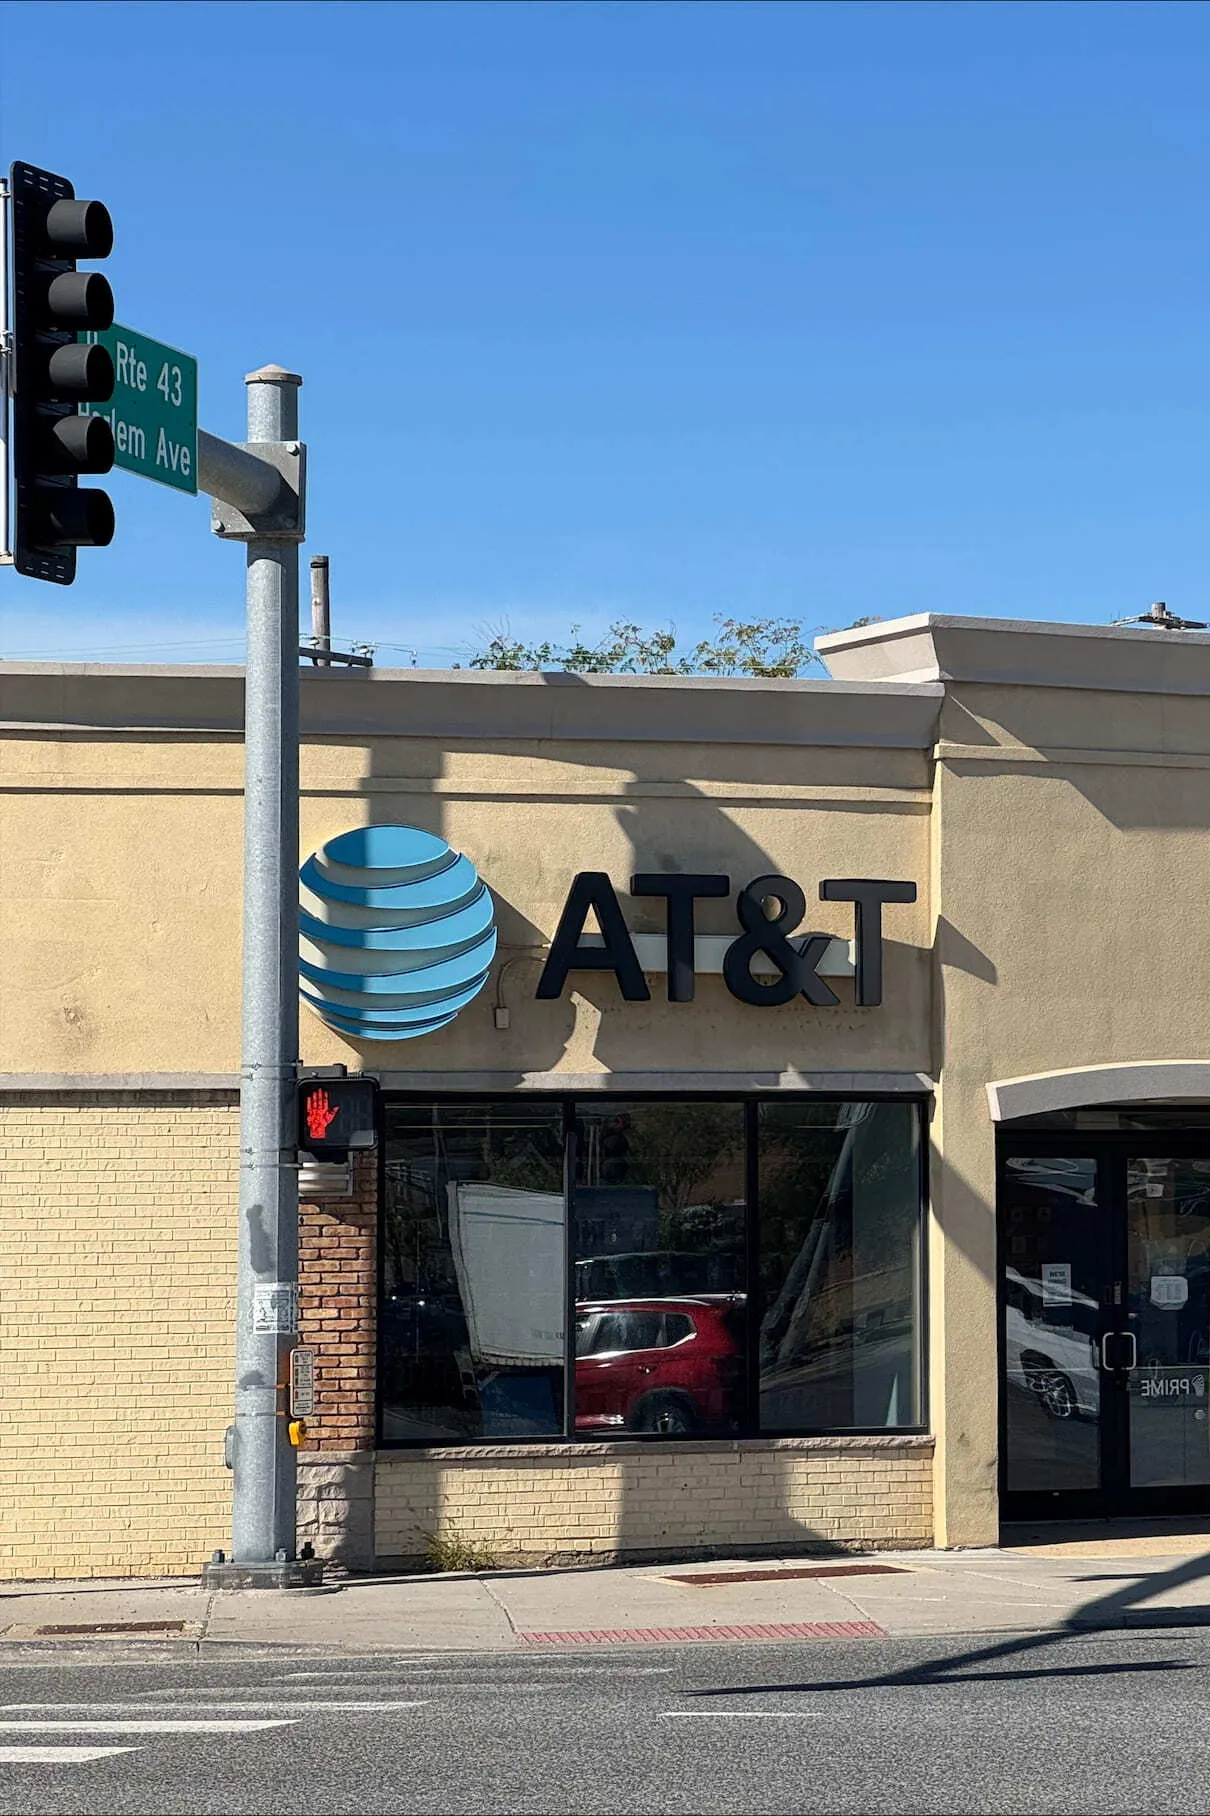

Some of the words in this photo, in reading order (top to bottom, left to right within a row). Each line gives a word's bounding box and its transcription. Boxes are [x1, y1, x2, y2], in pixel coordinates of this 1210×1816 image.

[116, 341, 147, 392] Rte
[157, 362, 182, 407] 43
[77, 402, 146, 460] lem
[156, 427, 191, 476] Ave
[535, 871, 917, 1007] AT&T
